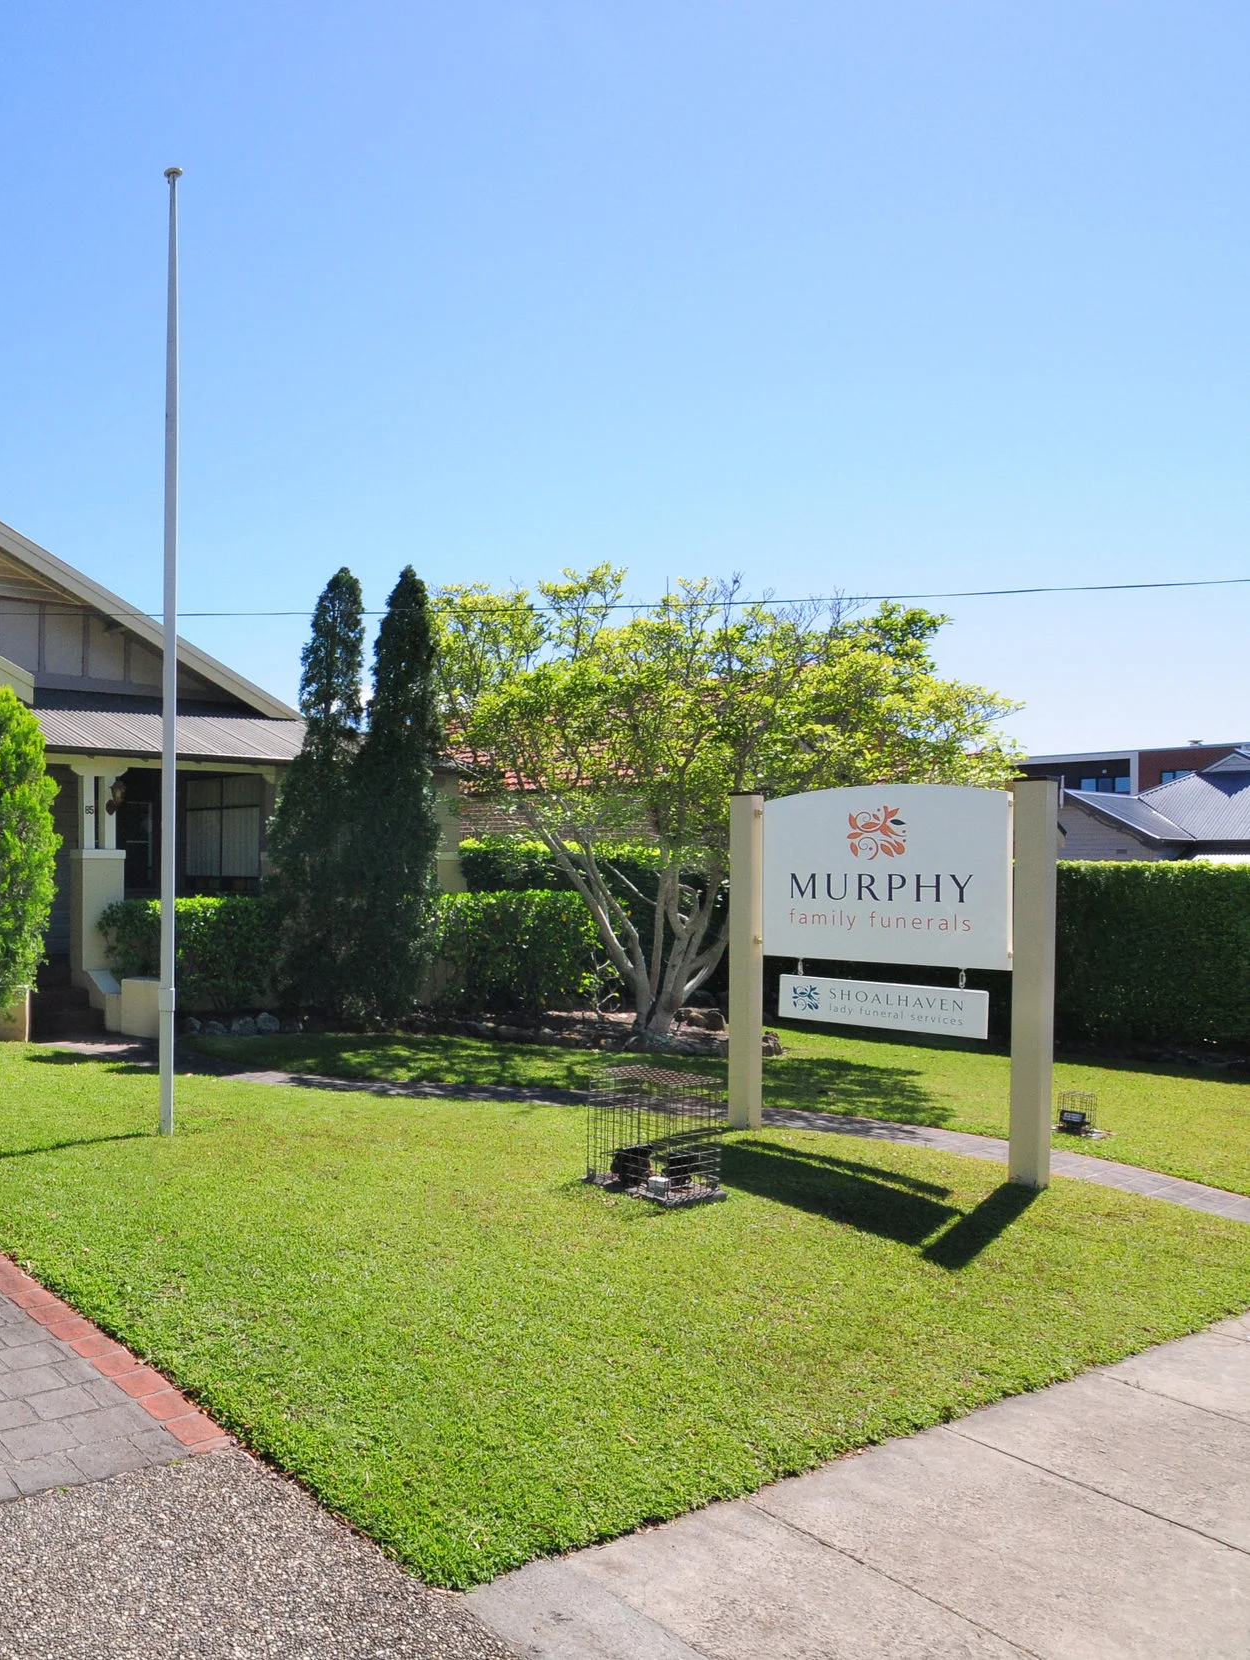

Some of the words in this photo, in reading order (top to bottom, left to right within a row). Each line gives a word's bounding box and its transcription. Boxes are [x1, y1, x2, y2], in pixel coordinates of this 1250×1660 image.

[85, 805, 94, 815] 85
[790, 873, 974, 904] MURPHY
[789, 908, 857, 931] family
[869, 911, 972, 932] funerals
[829, 987, 964, 1012] SHOALHAVEN
[829, 1003, 853, 1016] lady
[859, 1004, 904, 1020] funeral
[910, 1013, 964, 1027] services
